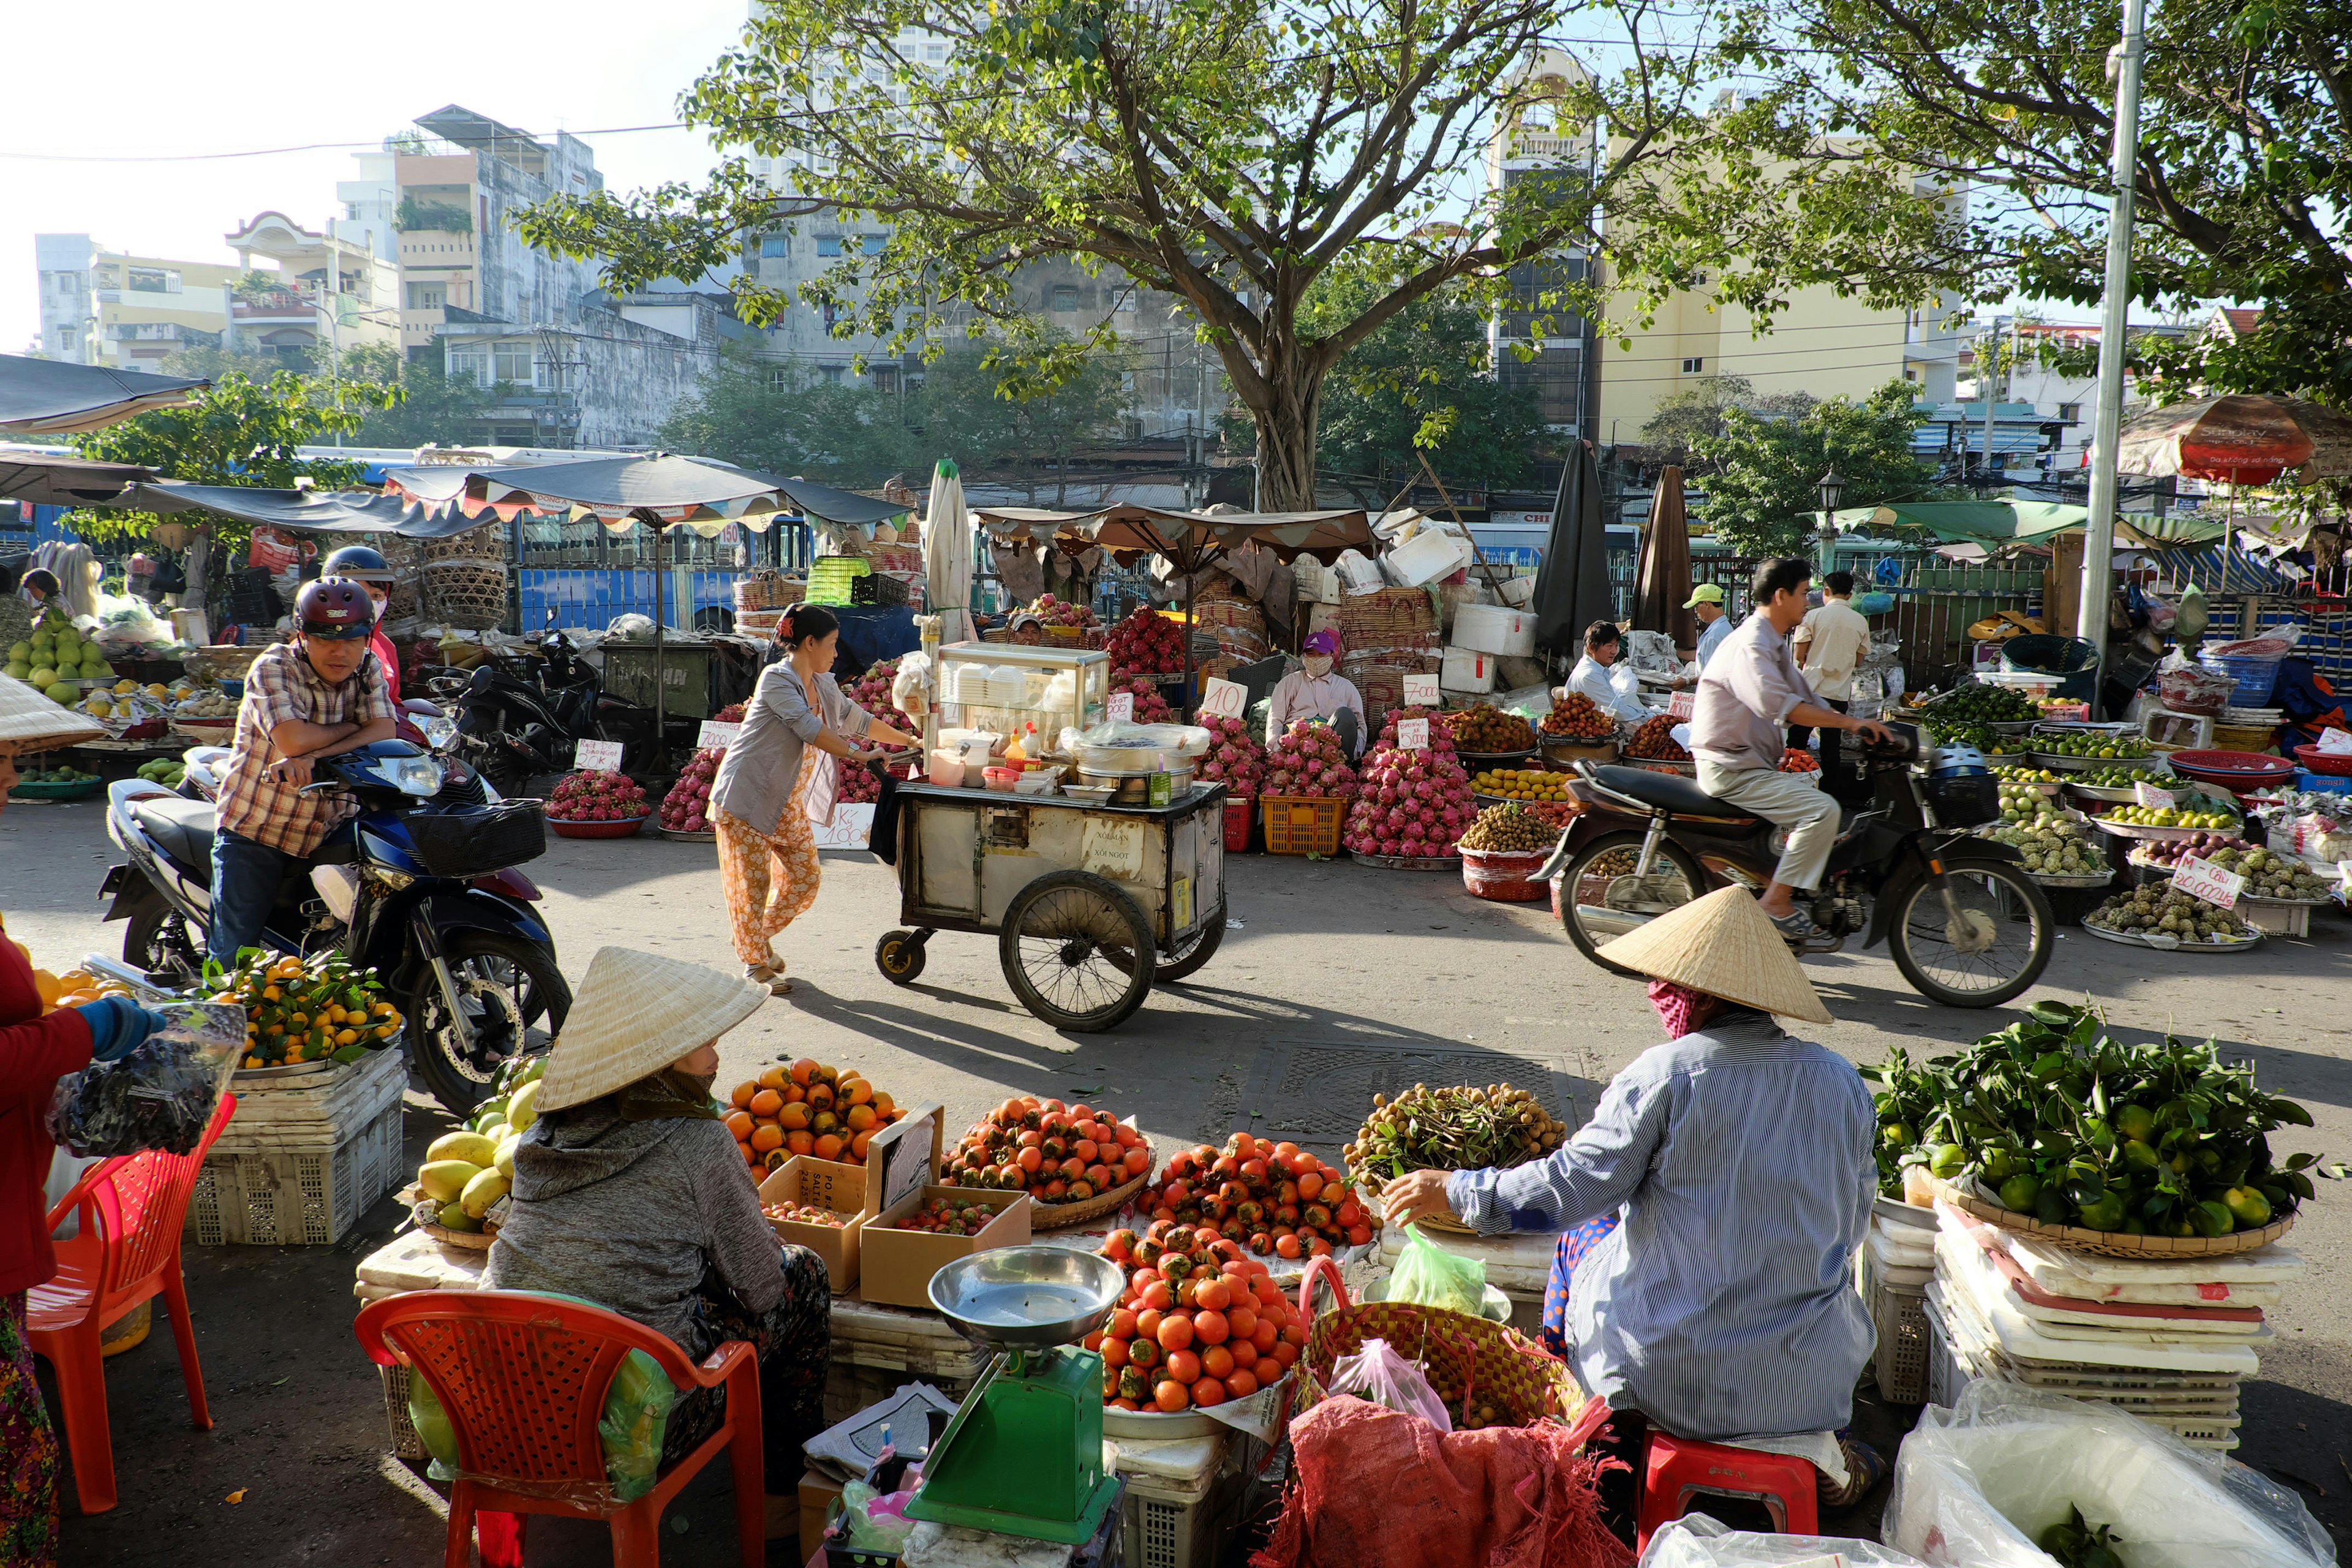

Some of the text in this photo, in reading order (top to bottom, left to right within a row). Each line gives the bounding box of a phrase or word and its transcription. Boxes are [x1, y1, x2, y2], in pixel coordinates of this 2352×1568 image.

[2201, 427, 2266, 439] Sunplay
[722, 524, 738, 543] 150
[1207, 686, 1240, 712] 10
[1404, 682, 1438, 703] 7000
[701, 731, 727, 747] 7000
[1401, 733, 1427, 748] 5000
[1095, 849, 1129, 860] XÔI NGỌT
[2182, 858, 2194, 870] M
